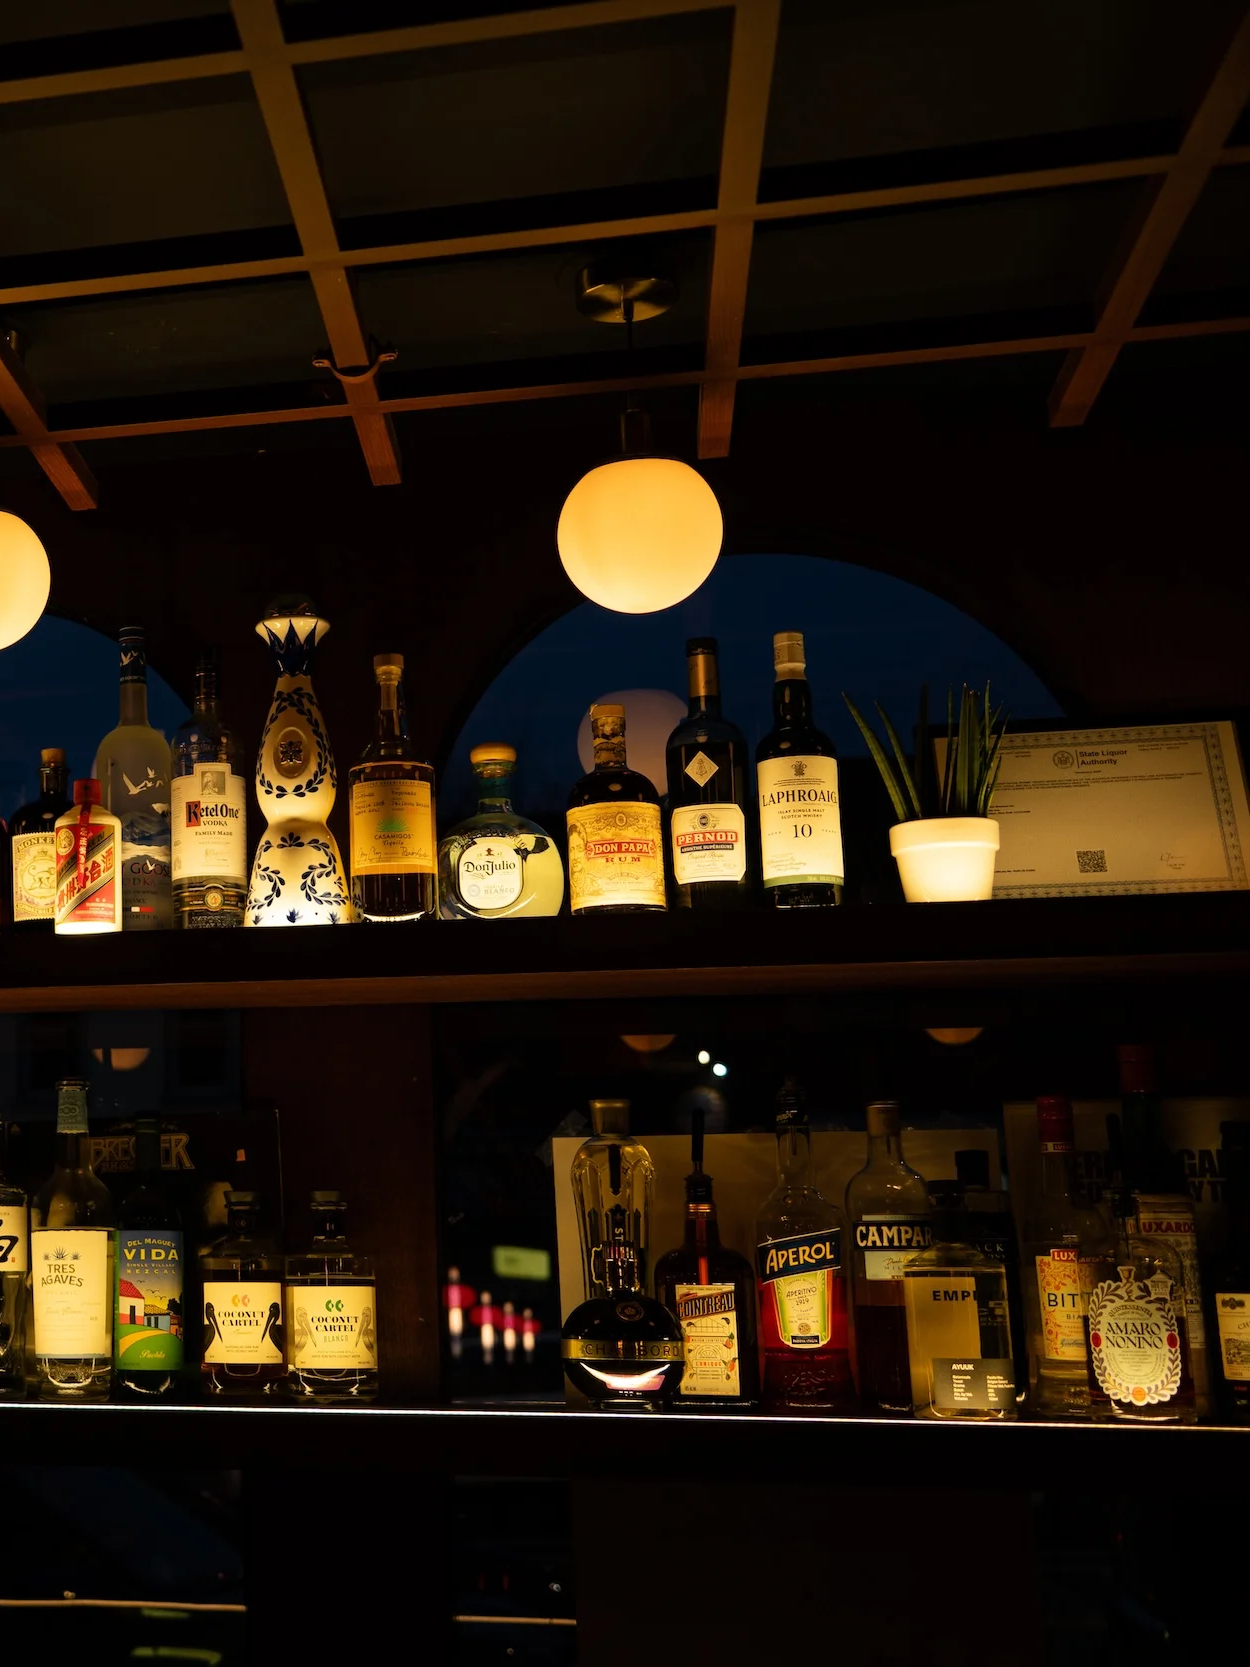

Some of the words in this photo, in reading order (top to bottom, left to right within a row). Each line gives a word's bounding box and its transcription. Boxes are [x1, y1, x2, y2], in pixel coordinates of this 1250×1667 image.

[1101, 749, 1128, 758] Liquor
[1080, 758, 1118, 766] Authority
[763, 789, 837, 807] LAPHROAIG
[187, 803, 218, 825] Ketel
[220, 803, 239, 819] One
[793, 824, 812, 838] 10
[18, 836, 55, 852] MONKE
[678, 833, 736, 845] PERNOD
[596, 843, 618, 853] DON
[622, 843, 649, 852] PAPA
[464, 861, 489, 872] Don
[486, 861, 516, 876] Julio
[89, 1133, 196, 1171] BRECER
[856, 1225, 933, 1247] CAMPAR
[144, 1238, 175, 1248] MAGUEY
[123, 1249, 179, 1260] VIDA
[766, 1241, 834, 1274] APEROL
[47, 1264, 75, 1274] TRES
[41, 1275, 83, 1287] AGAVES
[786, 1286, 817, 1297] APERITIVO
[679, 1292, 734, 1318] COINTREAU
[1106, 1322, 1161, 1336] AMARO
[323, 1334, 349, 1343] BLANCO
[1106, 1336, 1164, 1350] NONINO
[585, 1344, 680, 1356] CHBORD
